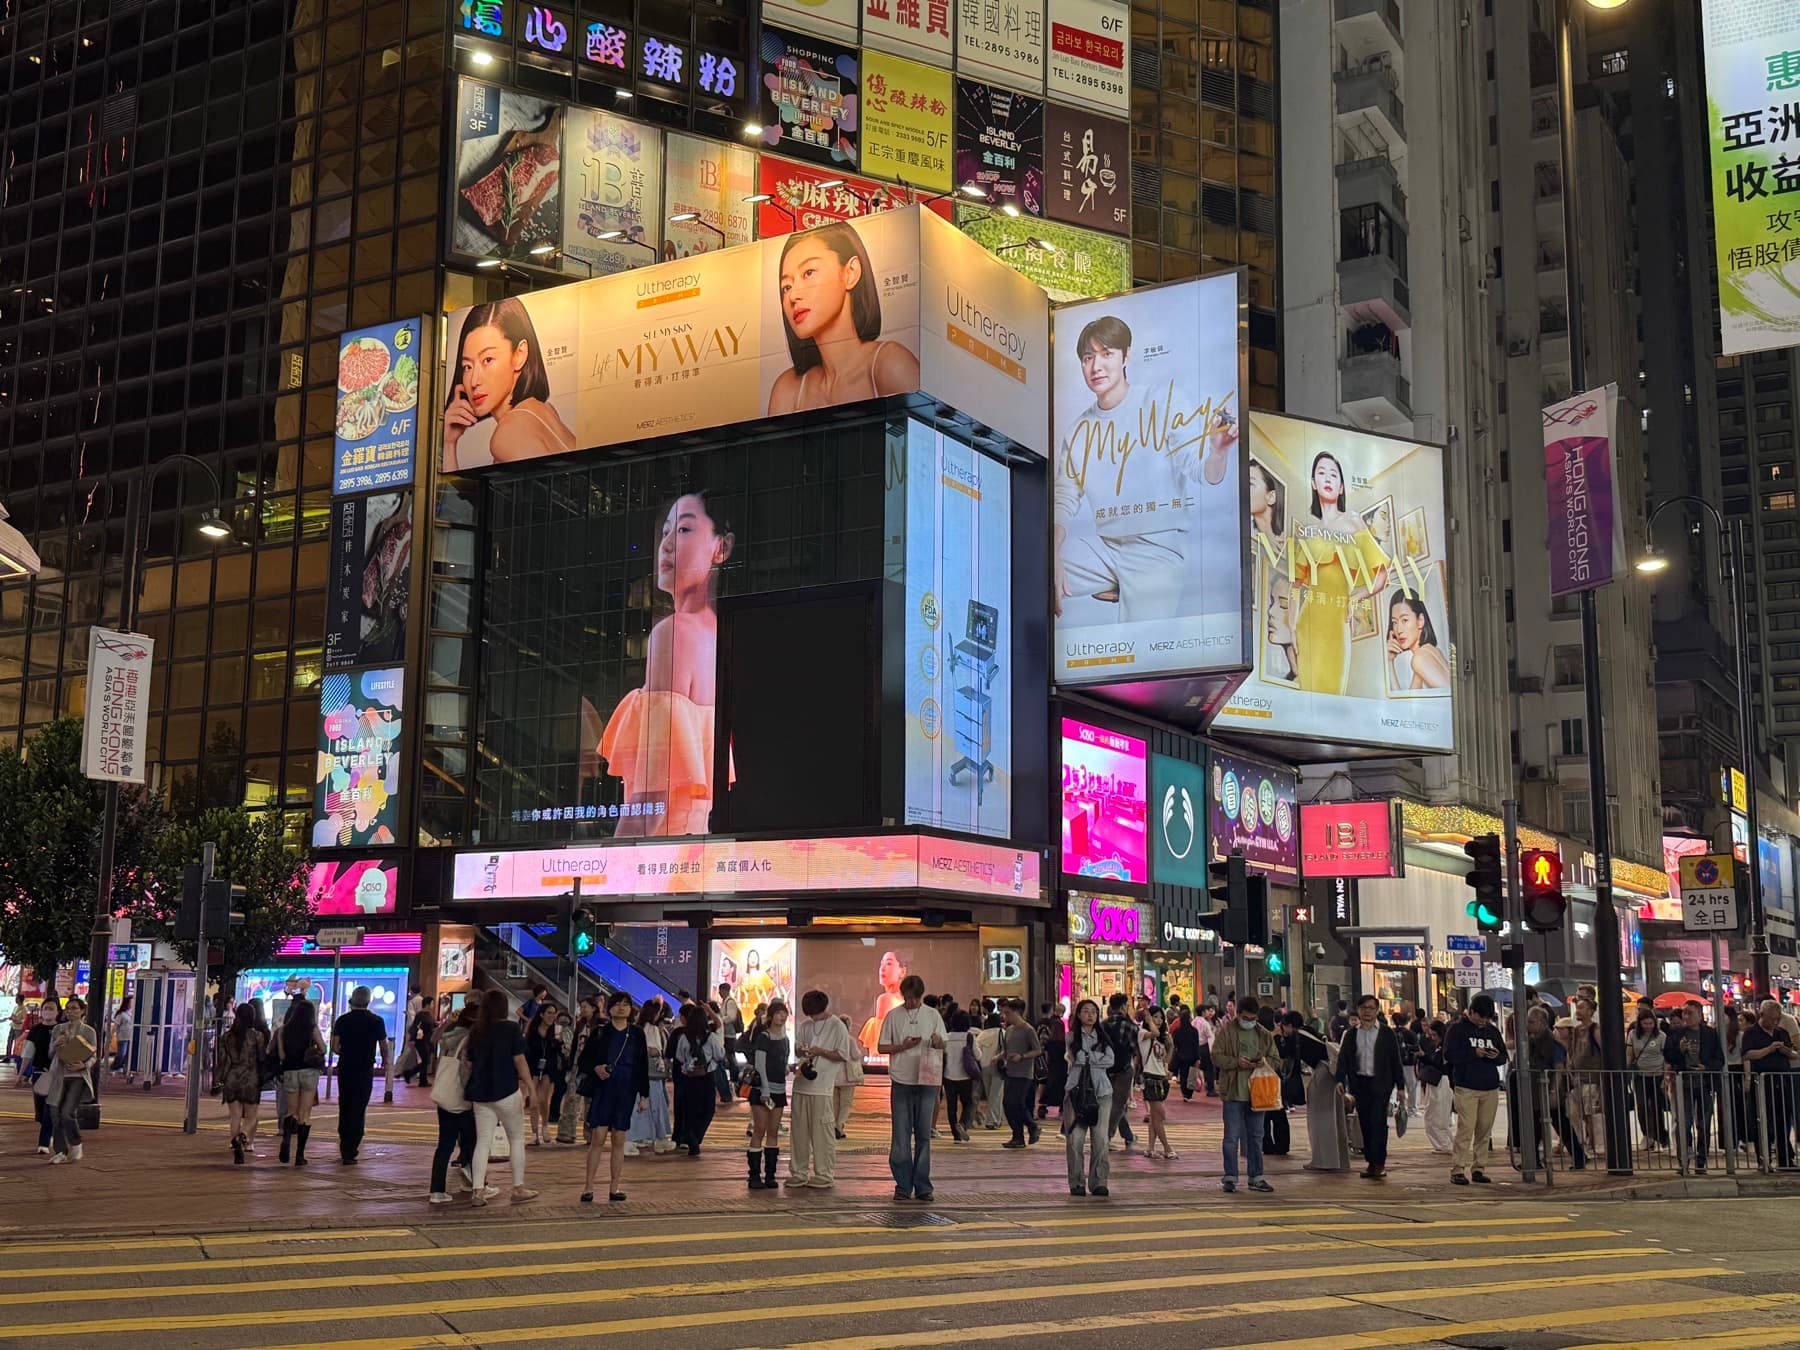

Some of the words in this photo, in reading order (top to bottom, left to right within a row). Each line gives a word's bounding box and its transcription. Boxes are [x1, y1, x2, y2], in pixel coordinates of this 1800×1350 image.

[963, 0, 1041, 47] 韓國料理
[1101, 16, 1123, 32] 6/F
[787, 45, 834, 64] SHOPPING
[964, 35, 1010, 57] TEL:2895
[1014, 48, 1039, 65] 3986
[1056, 30, 1082, 49] 금라보
[1086, 38, 1119, 60] 한국요리
[783, 78, 838, 100] ISLAND
[1100, 79, 1123, 94] 6398
[771, 90, 849, 120] BEVERLEY
[469, 119, 487, 131] 3F
[791, 125, 829, 146] 金百利
[986, 126, 1014, 140] ISLAND
[927, 130, 949, 149] 5/F
[979, 134, 1021, 152] BEVERLEY
[868, 141, 946, 172] 正宗重慶風味
[983, 150, 1015, 170] 金百利
[704, 209, 723, 225] 2890
[728, 215, 747, 230] 6870
[1114, 207, 1127, 222] 5F
[637, 272, 701, 297] Ultherapy
[946, 285, 1027, 361] Ultherapy
[616, 338, 667, 379] MY
[671, 320, 748, 367] WAY
[951, 328, 1023, 380] PRIME
[391, 418, 412, 436] 6/F
[1065, 418, 1138, 497] My
[1139, 378, 1235, 461] Way
[374, 471, 391, 484] 2895
[392, 468, 409, 481] 6398
[942, 456, 982, 490] Ultherapy
[1564, 452, 1573, 496] ASIA'S
[1571, 446, 1587, 511] HONG
[1096, 497, 1195, 520] 成就您的獨一無二
[1566, 498, 1576, 547] WORLD
[1299, 526, 1317, 537] SEE
[1318, 529, 1333, 541] MY
[1334, 532, 1358, 545] SKIN
[1575, 514, 1590, 581] KONG
[1257, 532, 1323, 585] MY
[1336, 544, 1434, 602] WAY
[1569, 550, 1578, 582] CITY
[327, 632, 342, 646] 3F
[1066, 640, 1135, 657] Ultherapy
[1149, 640, 1175, 652] MERZ
[104, 666, 113, 702] ASIA'S
[110, 667, 125, 719] HONG
[370, 680, 396, 691] LIFESTYLE
[1228, 693, 1273, 710] ltherapy
[1381, 717, 1399, 728] MERZ
[101, 704, 110, 745] WORLD
[108, 723, 121, 776] KONG
[335, 736, 384, 753] ISLAND
[99, 747, 108, 774] CITY
[325, 751, 393, 769] BEVERLEY
[541, 857, 608, 874] Ultherapy
[637, 860, 701, 876] 看得見的提拉
[716, 858, 772, 874] 高度個人化
[932, 856, 953, 871] MERZ
[1336, 895, 1346, 919] WALK
[1689, 894, 1706, 907] 24
[1709, 894, 1730, 906] hrs
[1694, 909, 1727, 925] 全日
[1174, 926, 1185, 938] THE
[1186, 927, 1200, 940] BODY
[1200, 929, 1215, 941] SHOP
[678, 950, 693, 963] 3F
[1460, 978, 1476, 986] 全日
